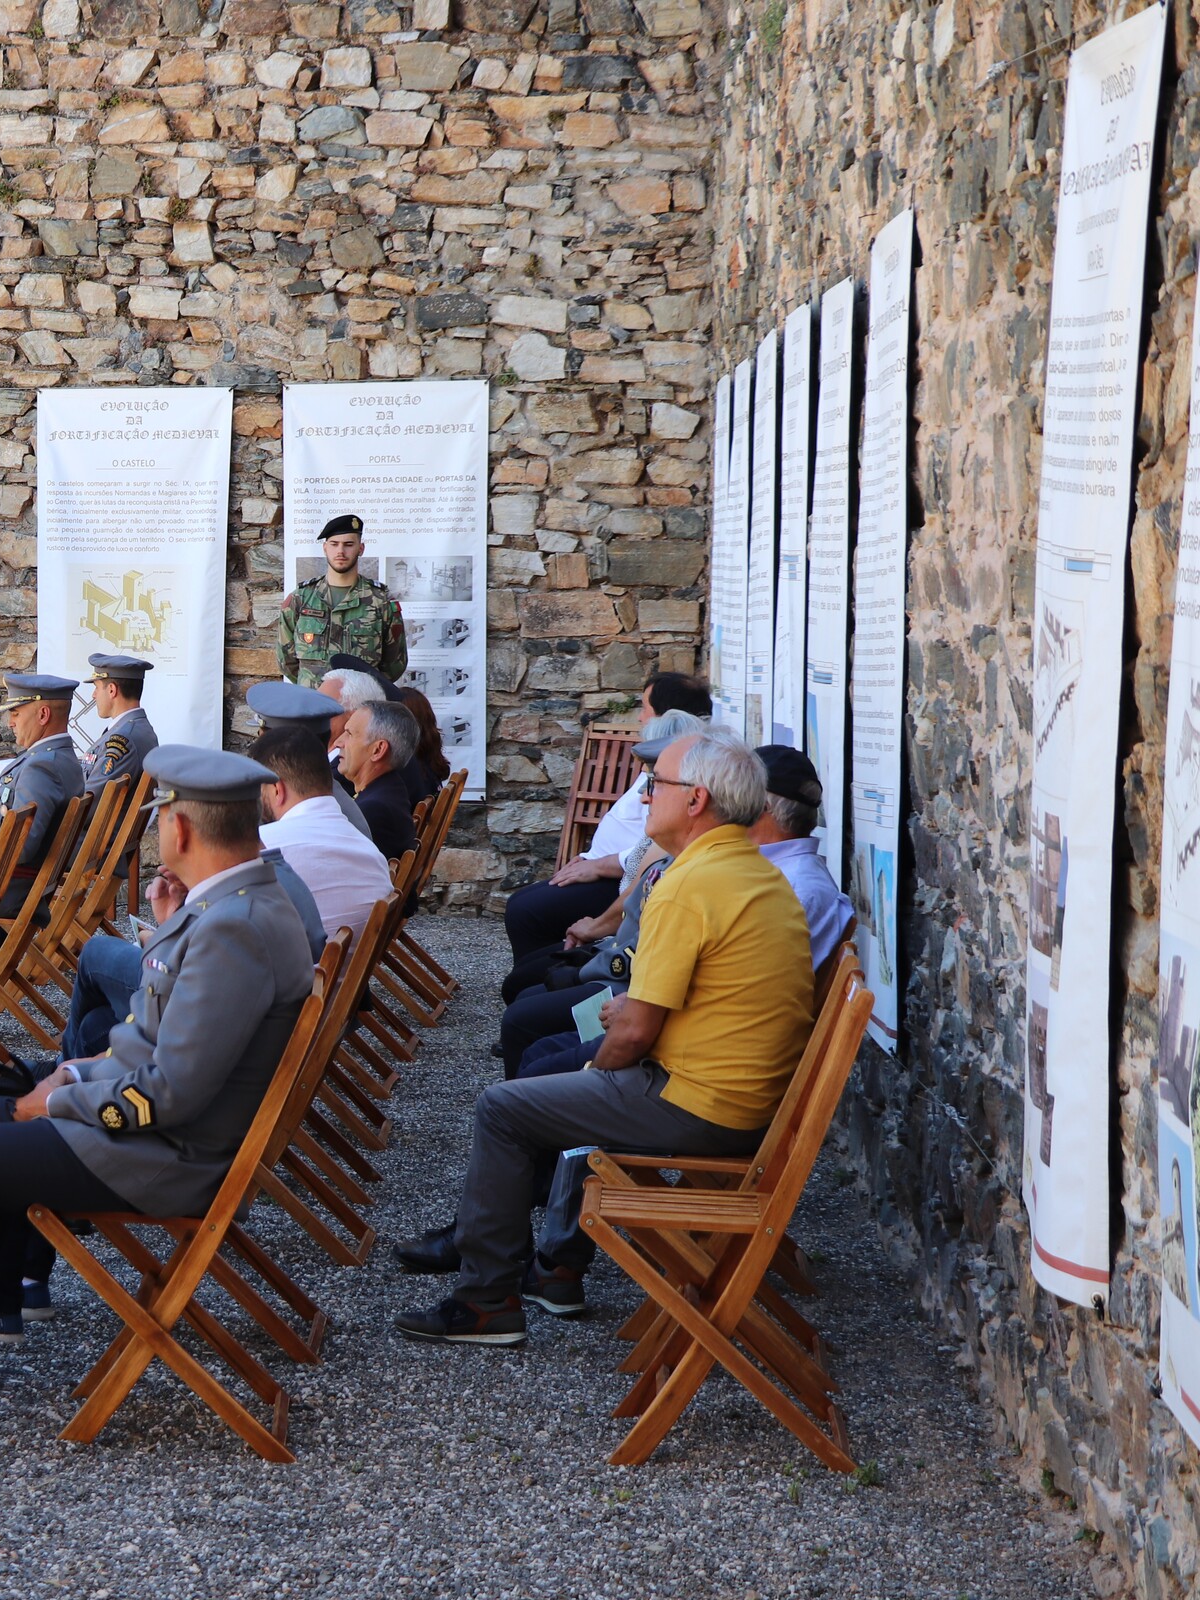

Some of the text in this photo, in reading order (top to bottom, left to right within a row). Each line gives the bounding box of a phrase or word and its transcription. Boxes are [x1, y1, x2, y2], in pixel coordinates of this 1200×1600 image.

[349, 394, 421, 407] EVOLUÇÃO
[100, 400, 169, 412] EVOLUÇÃO
[376, 411, 394, 420] DA
[126, 416, 143, 425] DA
[121, 459, 156, 467] CASTELO
[369, 455, 401, 463] PORTAS
